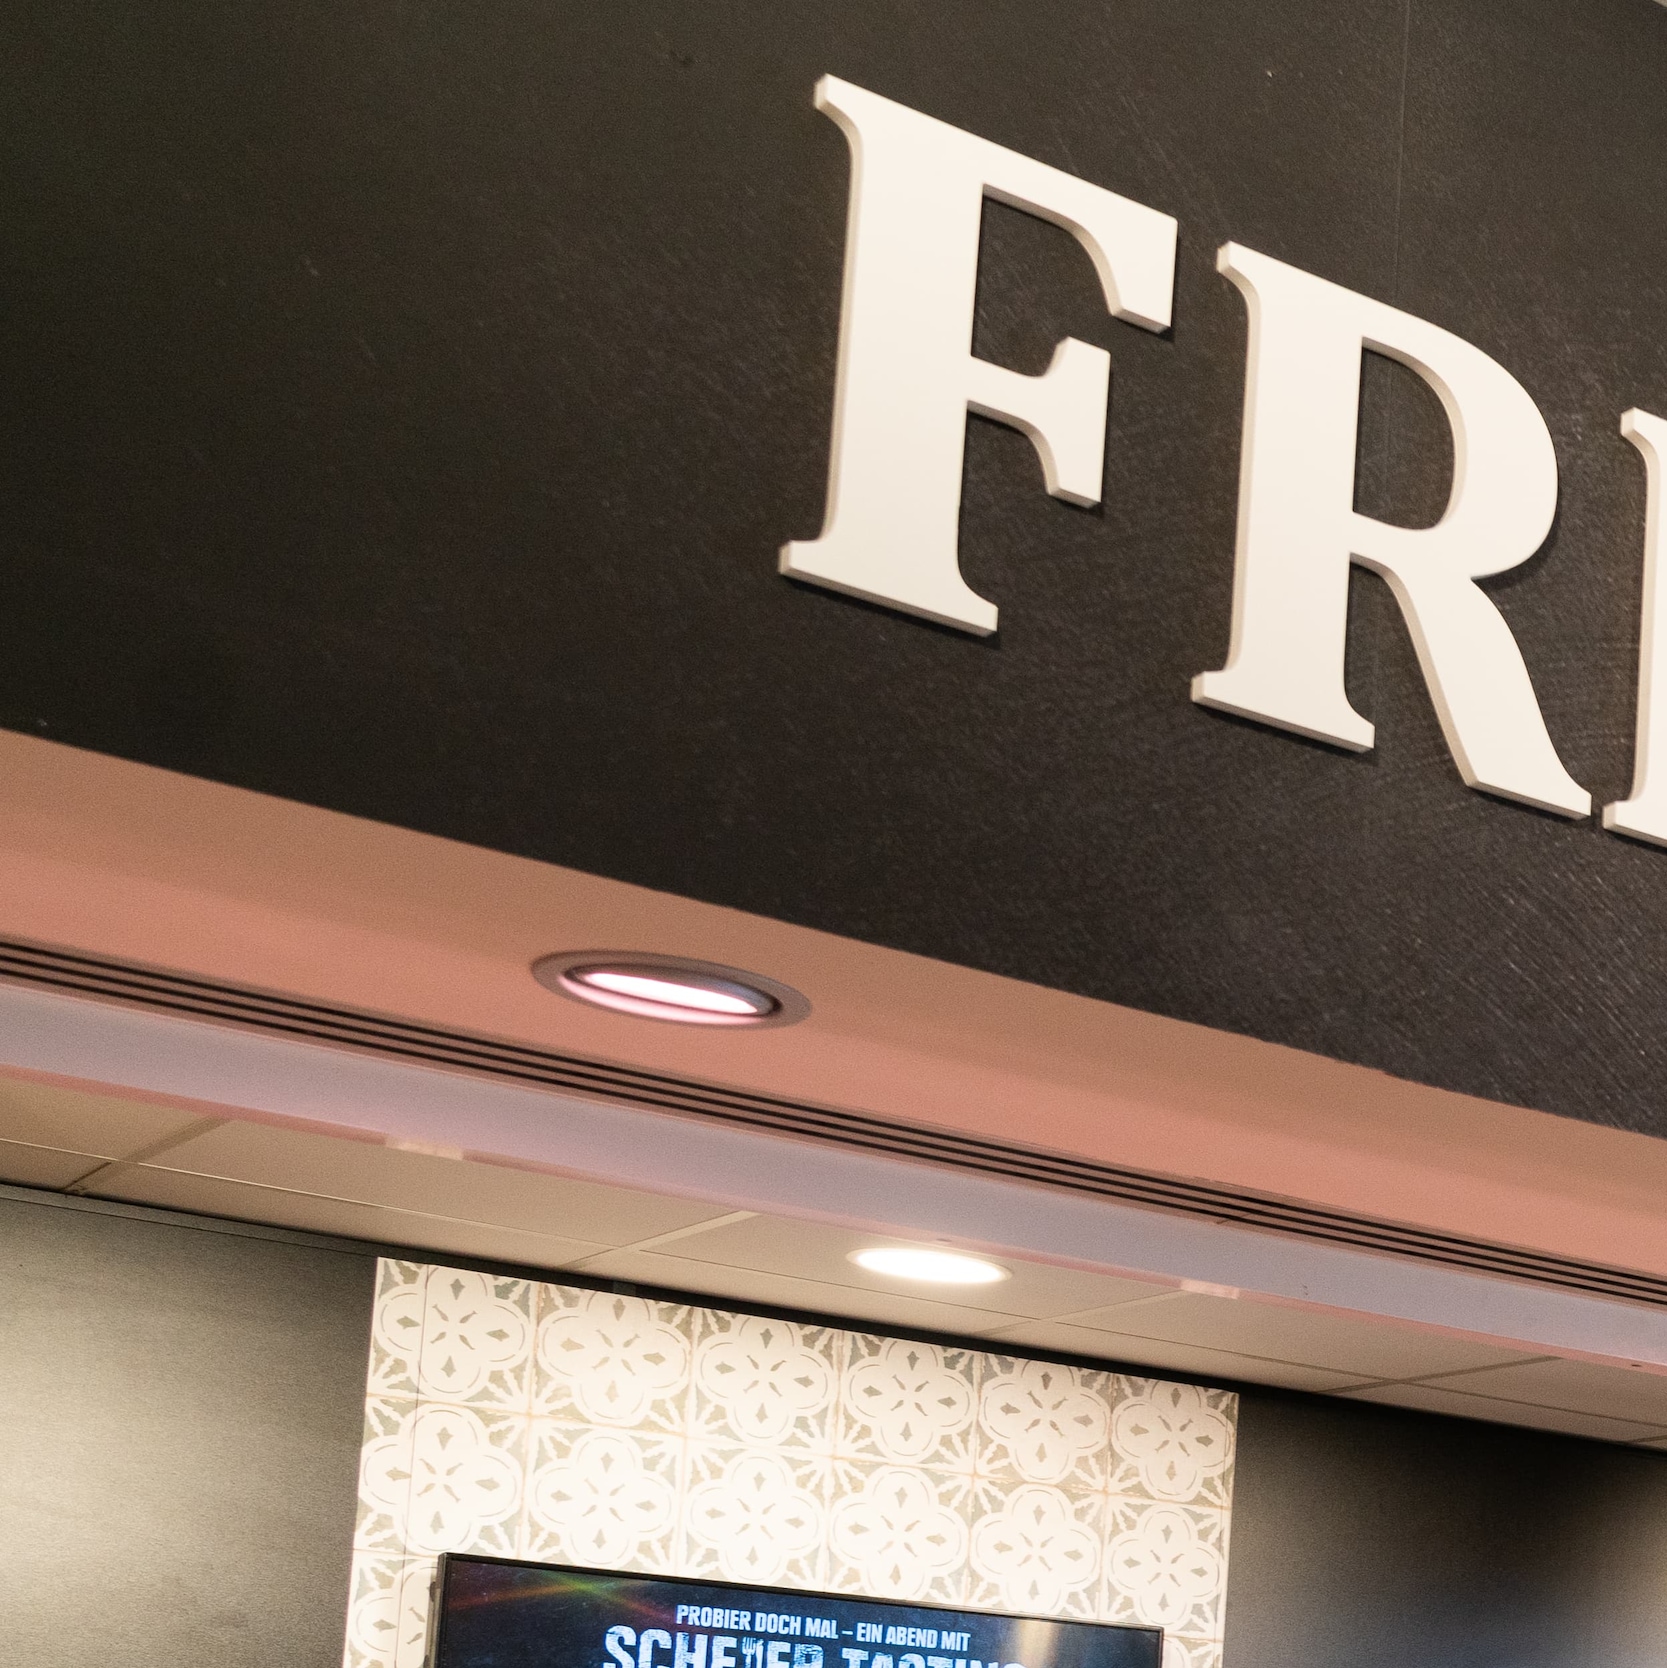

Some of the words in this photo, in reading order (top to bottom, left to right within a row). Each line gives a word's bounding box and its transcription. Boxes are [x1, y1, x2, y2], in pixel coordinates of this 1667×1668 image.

[676, 1604, 751, 1631] PROBIER
[754, 1612, 801, 1634] DOCH
[805, 1616, 839, 1639] MAL
[856, 1621, 883, 1643] EIN
[885, 1625, 939, 1649] ABEND
[941, 1630, 971, 1652] MIT
